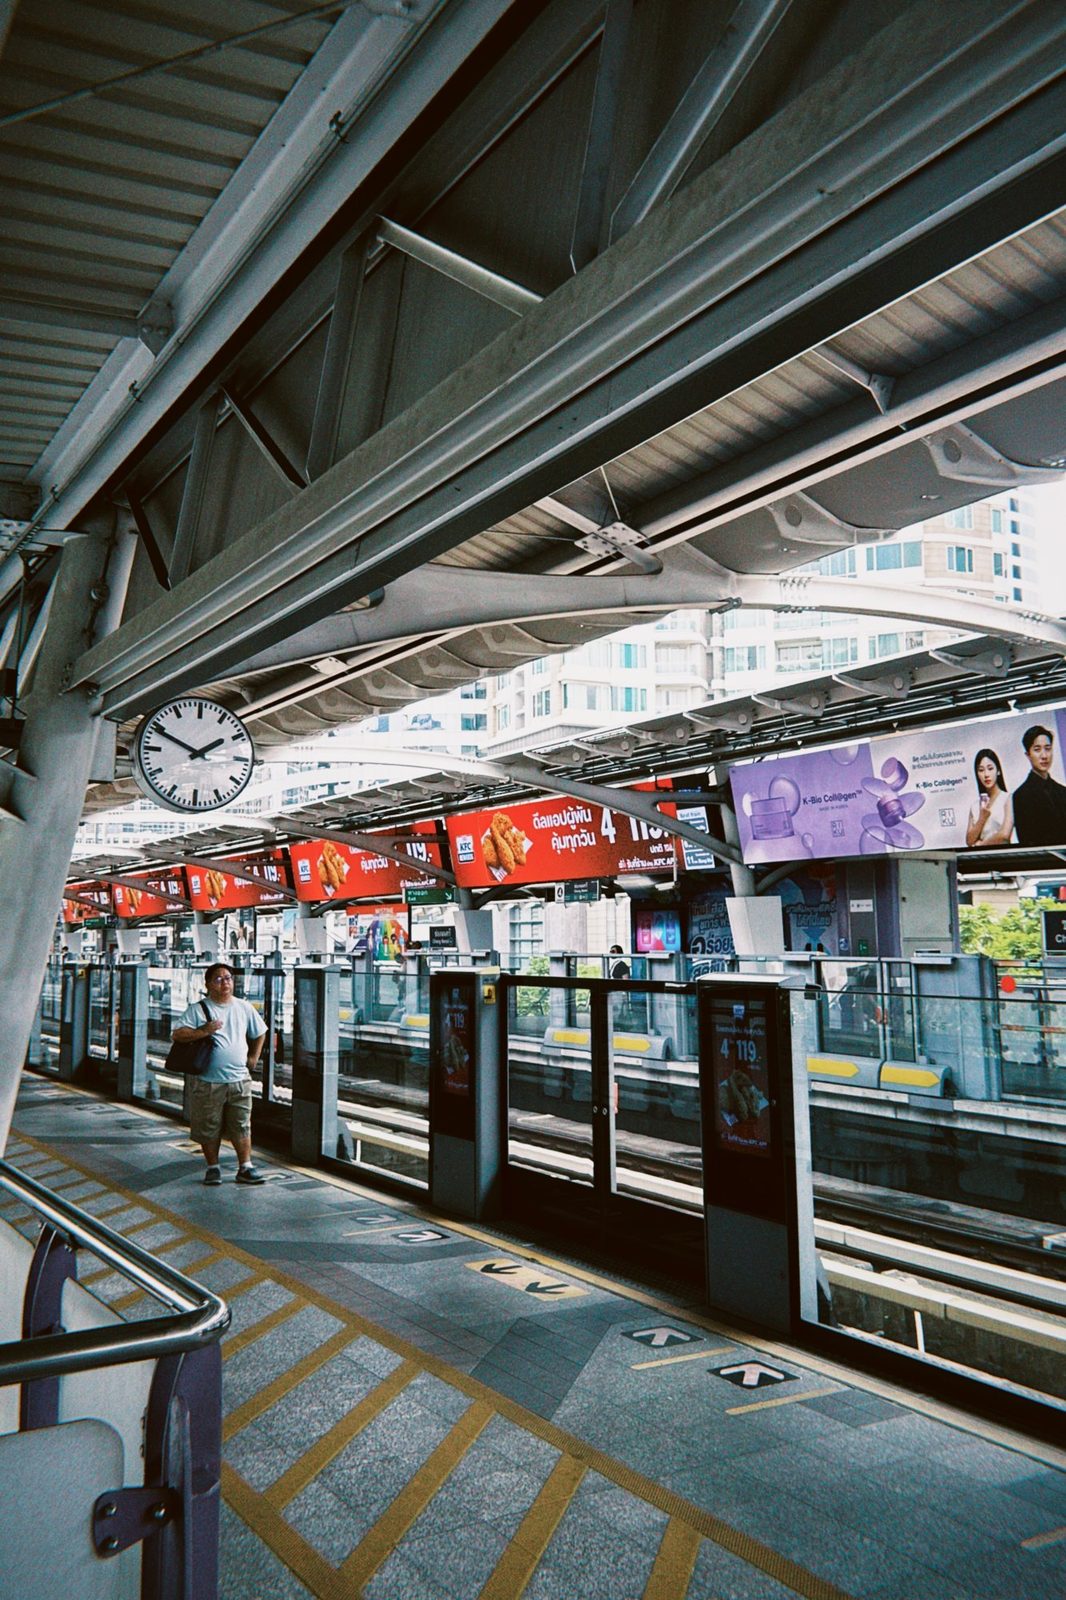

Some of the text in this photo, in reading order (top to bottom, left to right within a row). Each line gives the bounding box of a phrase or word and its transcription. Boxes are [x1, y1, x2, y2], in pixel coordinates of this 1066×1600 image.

[916, 780, 932, 789] K-Bio
[802, 796, 822, 805] K-Bio
[532, 805, 592, 830] ดีลแอปผู้พัน
[600, 807, 617, 844] 4
[460, 842, 471, 851] KFC
[551, 828, 596, 855] คุ้มทุกวัน
[653, 858, 666, 866] KFC
[720, 1038, 730, 1059] 4
